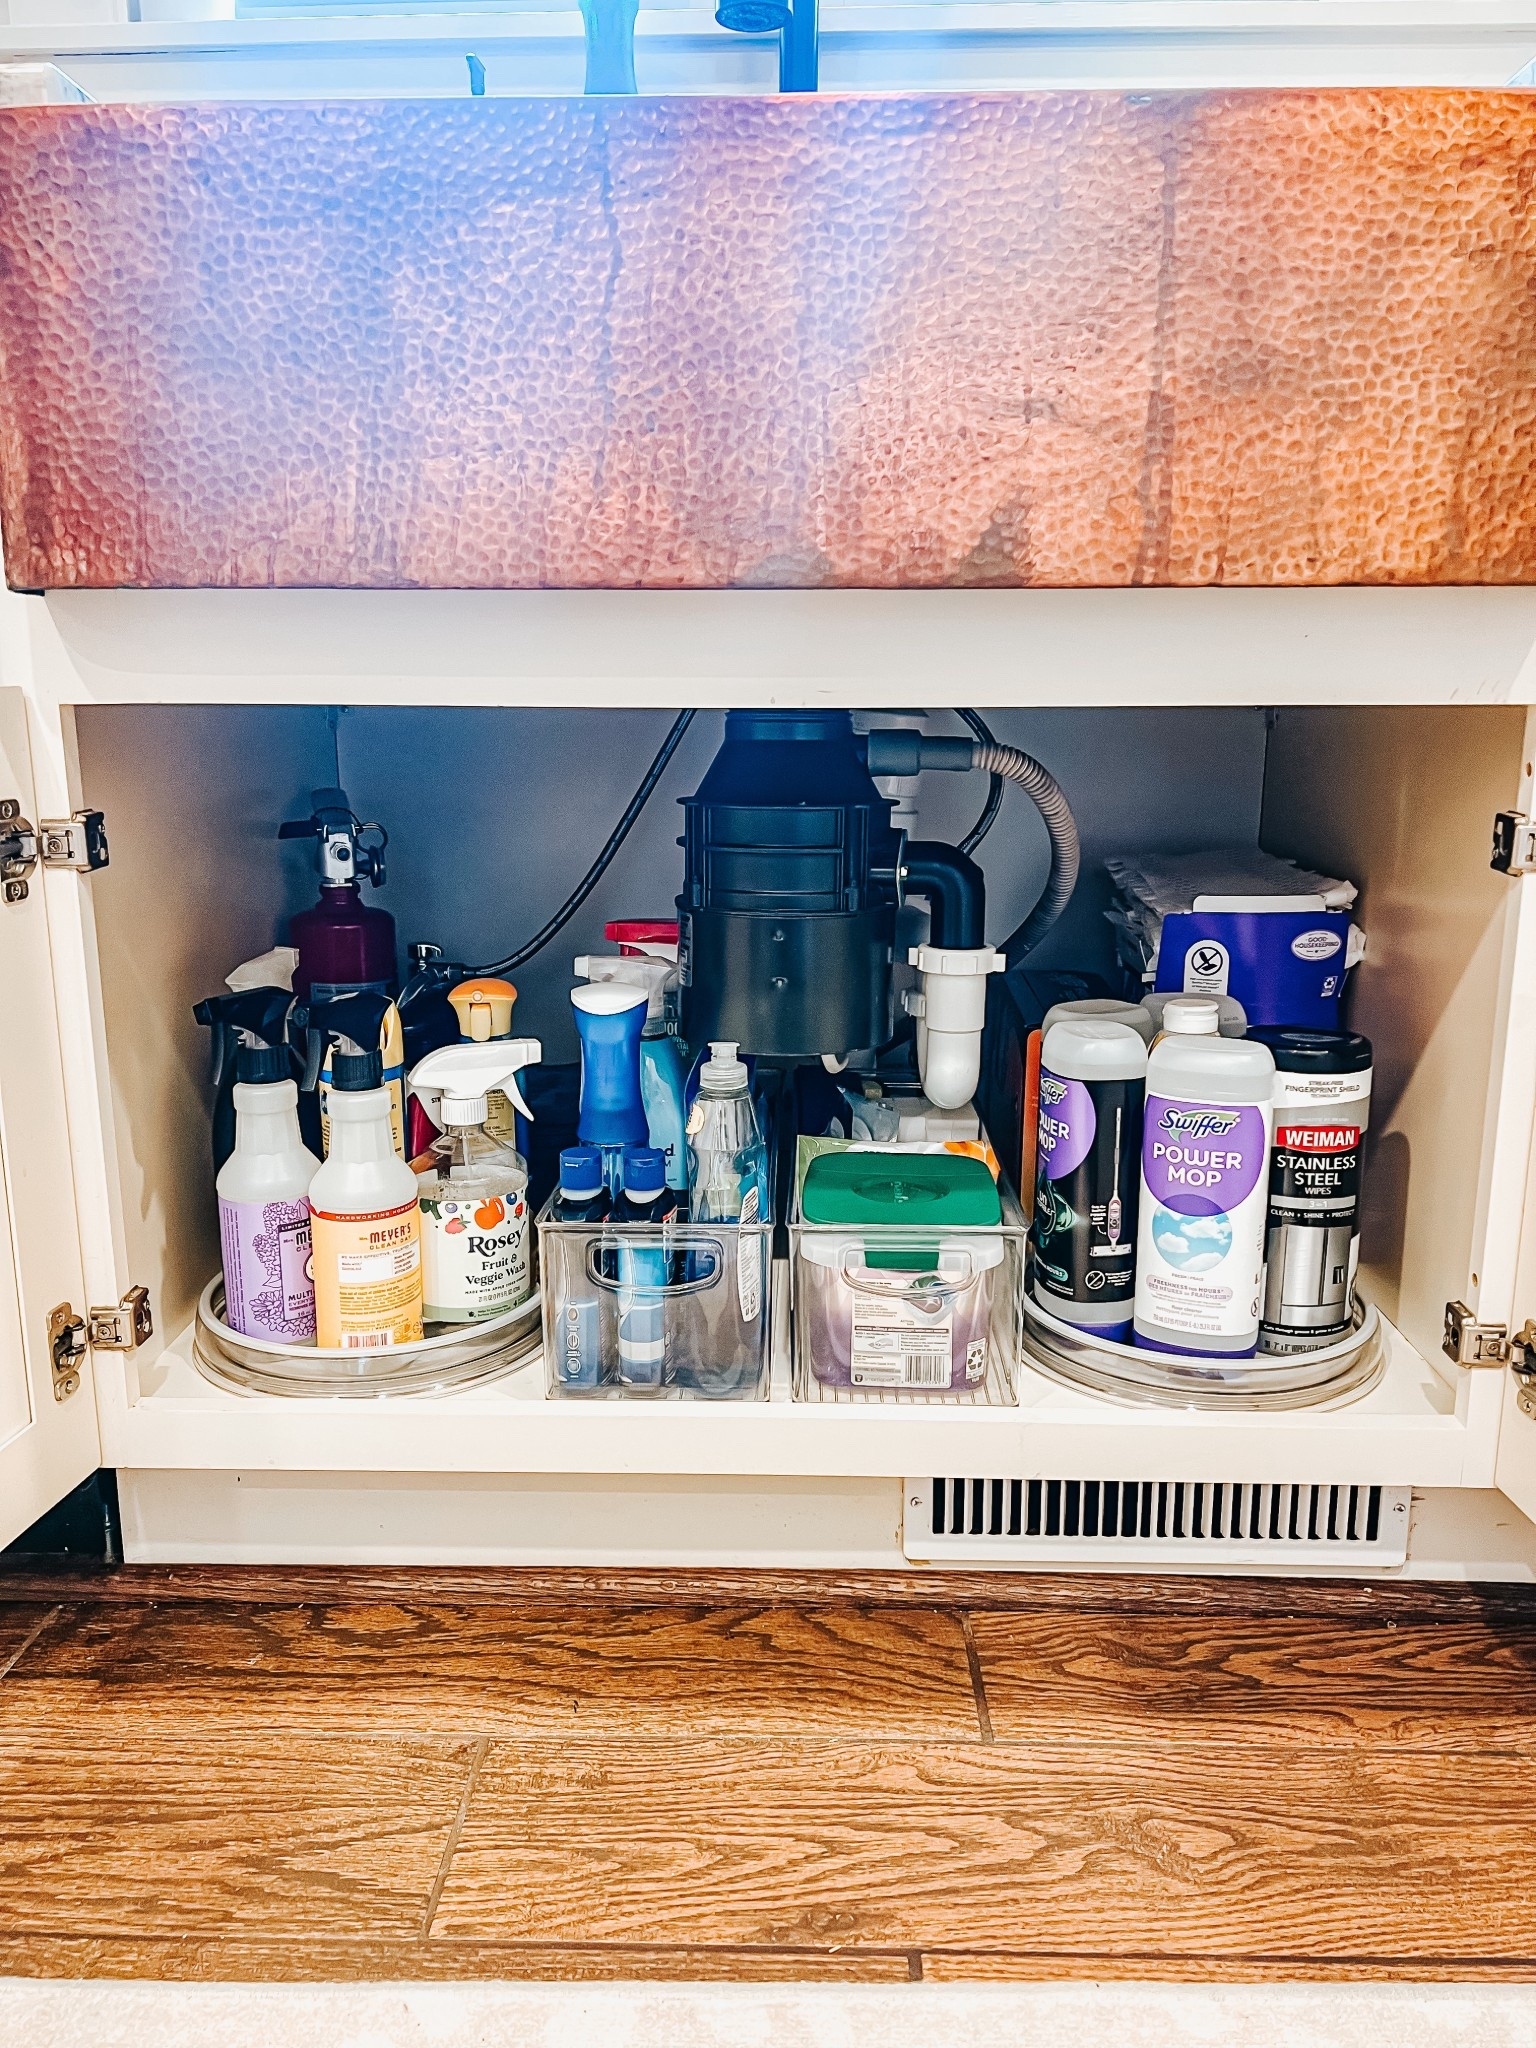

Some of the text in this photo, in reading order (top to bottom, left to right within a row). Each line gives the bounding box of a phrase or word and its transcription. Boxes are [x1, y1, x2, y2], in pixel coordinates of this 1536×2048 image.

[1285, 1084, 1361, 1093] FINGERPRINT SHIELD
[1159, 1109, 1234, 1138] Swiffer
[1285, 1129, 1355, 1147] WEIMAN
[1153, 1142, 1243, 1170] POWER
[1276, 1154, 1356, 1171] STAINLESS
[1167, 1164, 1222, 1187] MOP
[1294, 1171, 1342, 1186] STEEL
[1304, 1186, 1332, 1195] WIPES
[1270, 1208, 1295, 1218] CLEAN
[1331, 1209, 1356, 1218] PROTECT
[370, 1222, 411, 1244] MEYER'S
[468, 1220, 526, 1258] Rosey
[369, 1240, 397, 1251] CLEAN
[400, 1234, 412, 1244] DAY
[481, 1252, 518, 1271] Fruit &
[465, 1260, 526, 1287] Veggie Wash
[1153, 1278, 1188, 1290] FRESHNESS
